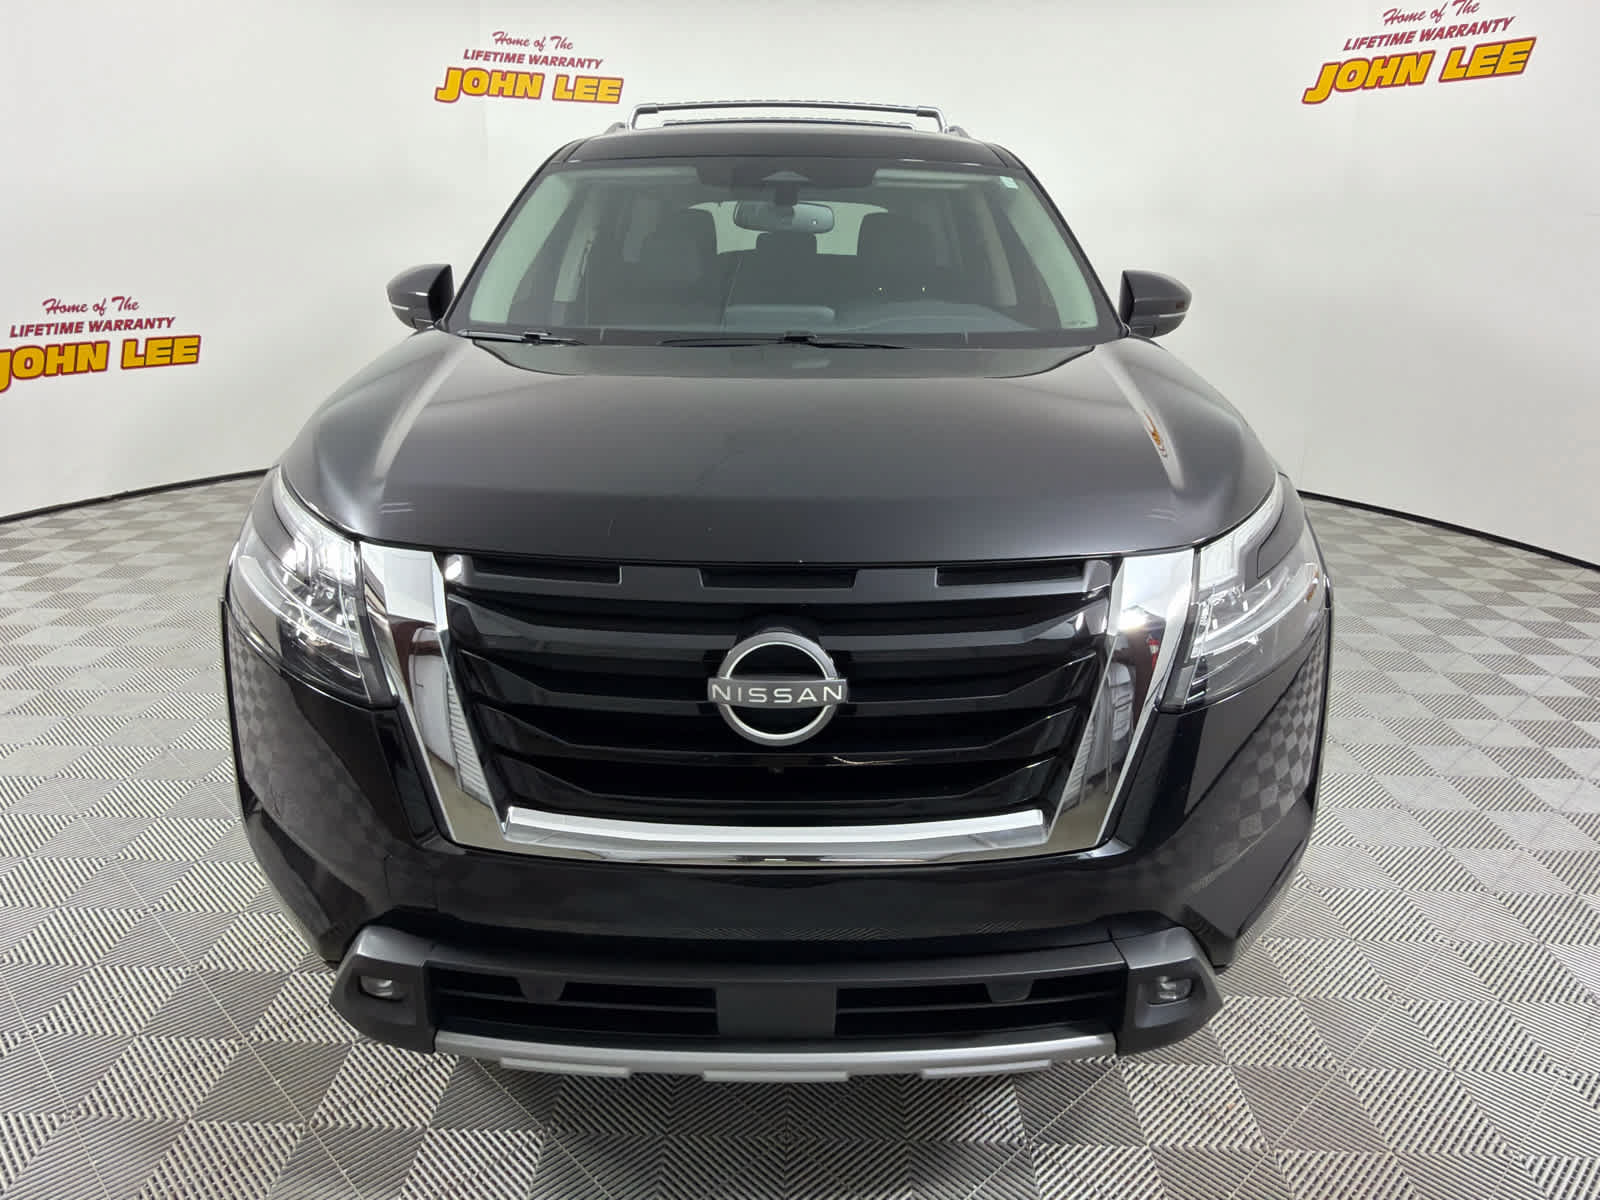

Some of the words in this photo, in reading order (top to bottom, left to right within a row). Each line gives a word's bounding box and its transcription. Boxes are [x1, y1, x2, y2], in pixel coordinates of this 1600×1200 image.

[1383, 7, 1427, 26] Home
[1430, 3, 1449, 23] of
[1451, 0, 1482, 16] The
[492, 31, 530, 46] Home
[533, 36, 546, 52] of
[550, 35, 574, 50] The
[1343, 30, 1416, 51] LIFETIME
[1418, 16, 1517, 42] WARRANTY
[463, 49, 526, 65] LIFETIME
[527, 53, 604, 70] WARRANTY
[1301, 49, 1437, 105] JOHN
[1438, 36, 1538, 83] LEE
[434, 66, 546, 104] JOHN
[551, 74, 625, 105] LEE
[42, 298, 89, 315] Home
[91, 298, 107, 317] of
[111, 296, 140, 312] The
[9, 321, 84, 338] LIFETIME
[88, 316, 177, 333] WARRANTY
[120, 334, 201, 370] LEE
[711, 684, 843, 704] NISSAN
